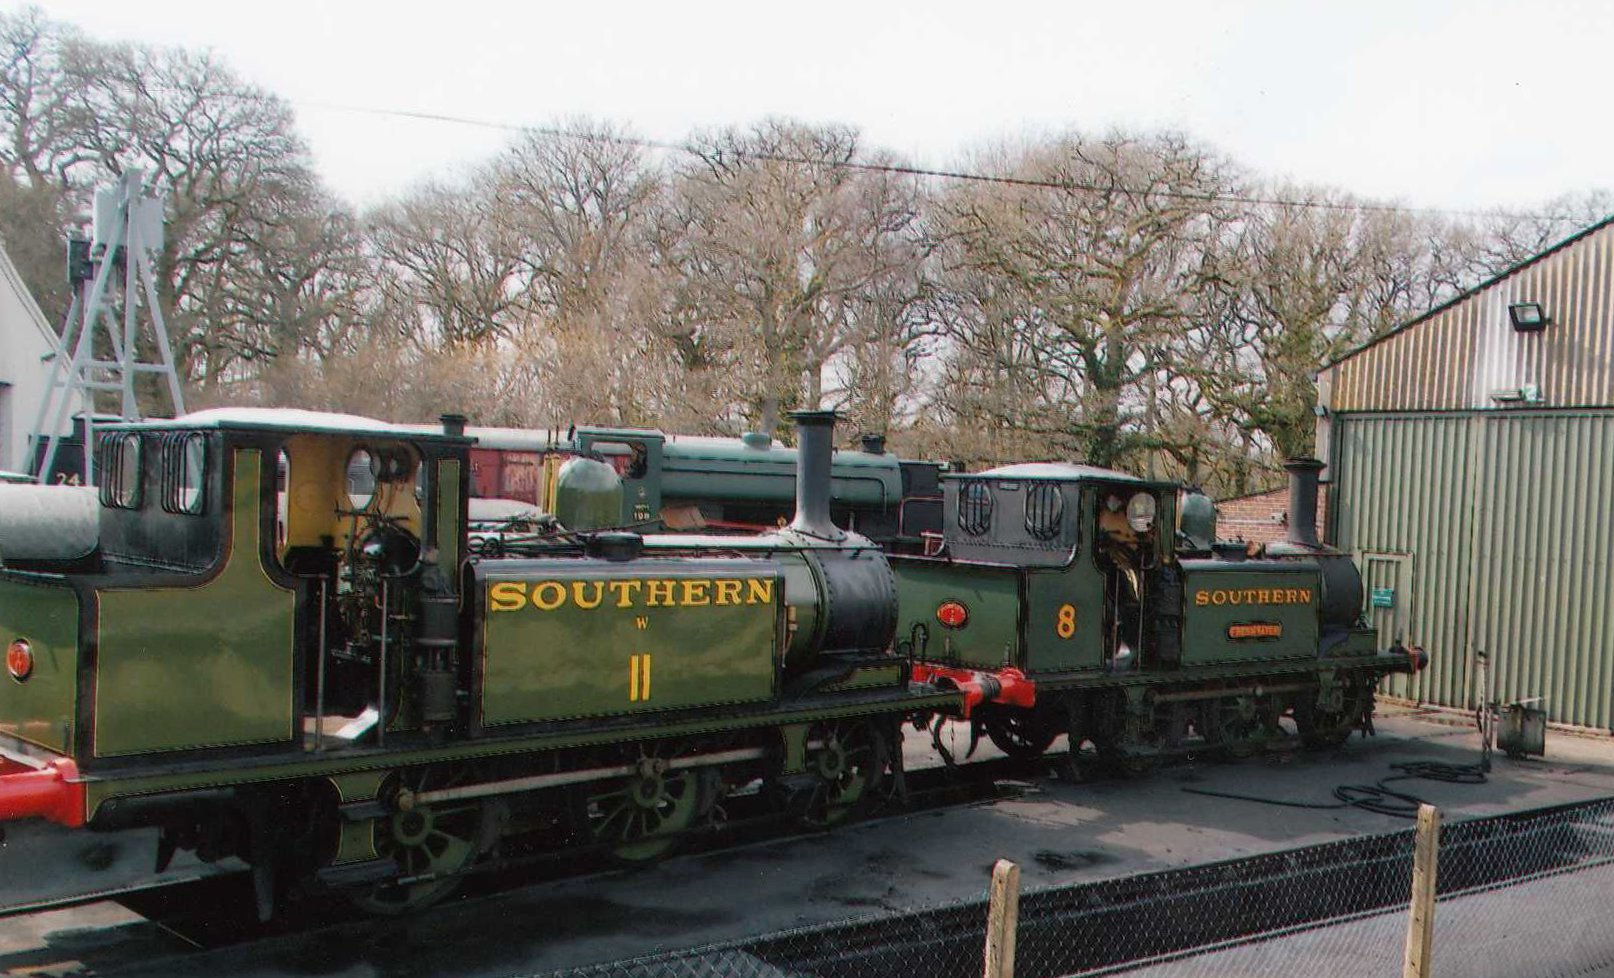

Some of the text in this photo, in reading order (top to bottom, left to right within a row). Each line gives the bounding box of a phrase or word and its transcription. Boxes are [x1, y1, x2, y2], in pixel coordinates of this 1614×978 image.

[56, 472, 82, 486] 24
[490, 578, 773, 612] SOUTHERN
[1195, 588, 1311, 605] SOUTHERN
[636, 615, 649, 630] W
[1057, 603, 1076, 640] 8
[629, 653, 651, 702] 11
